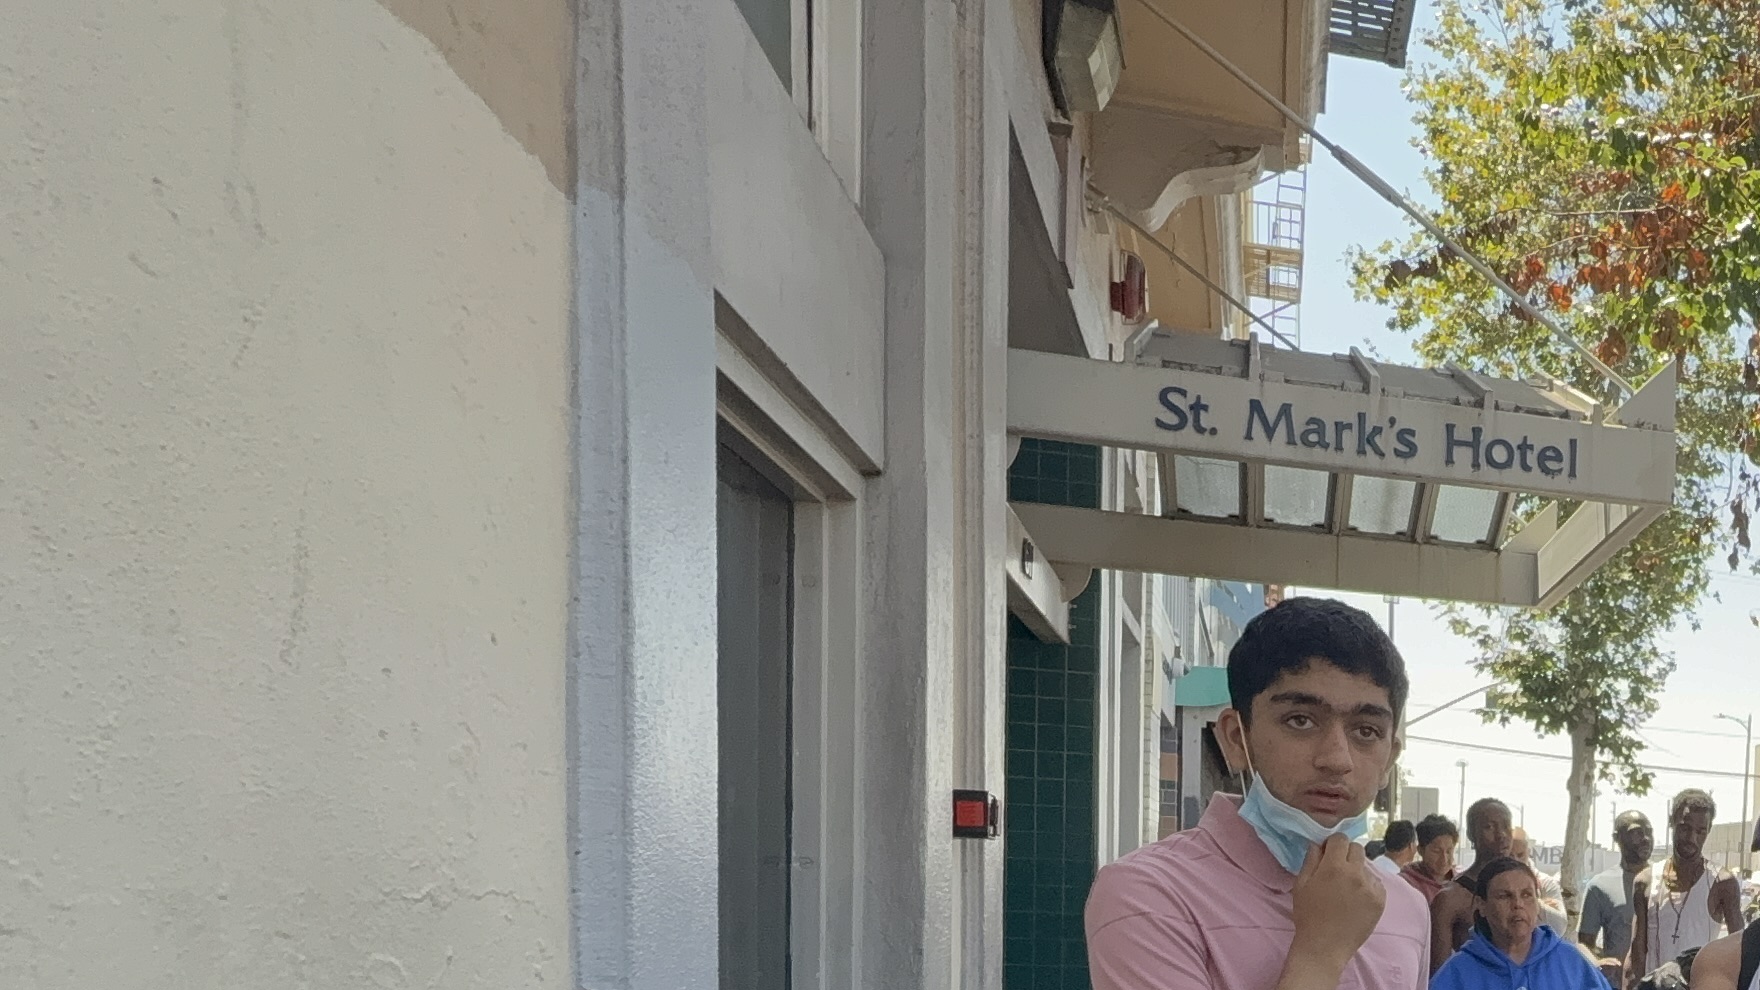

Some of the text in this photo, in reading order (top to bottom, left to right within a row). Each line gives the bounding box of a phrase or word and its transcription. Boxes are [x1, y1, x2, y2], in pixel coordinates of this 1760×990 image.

[1154, 386, 1579, 479] St. Mark's Hotel
